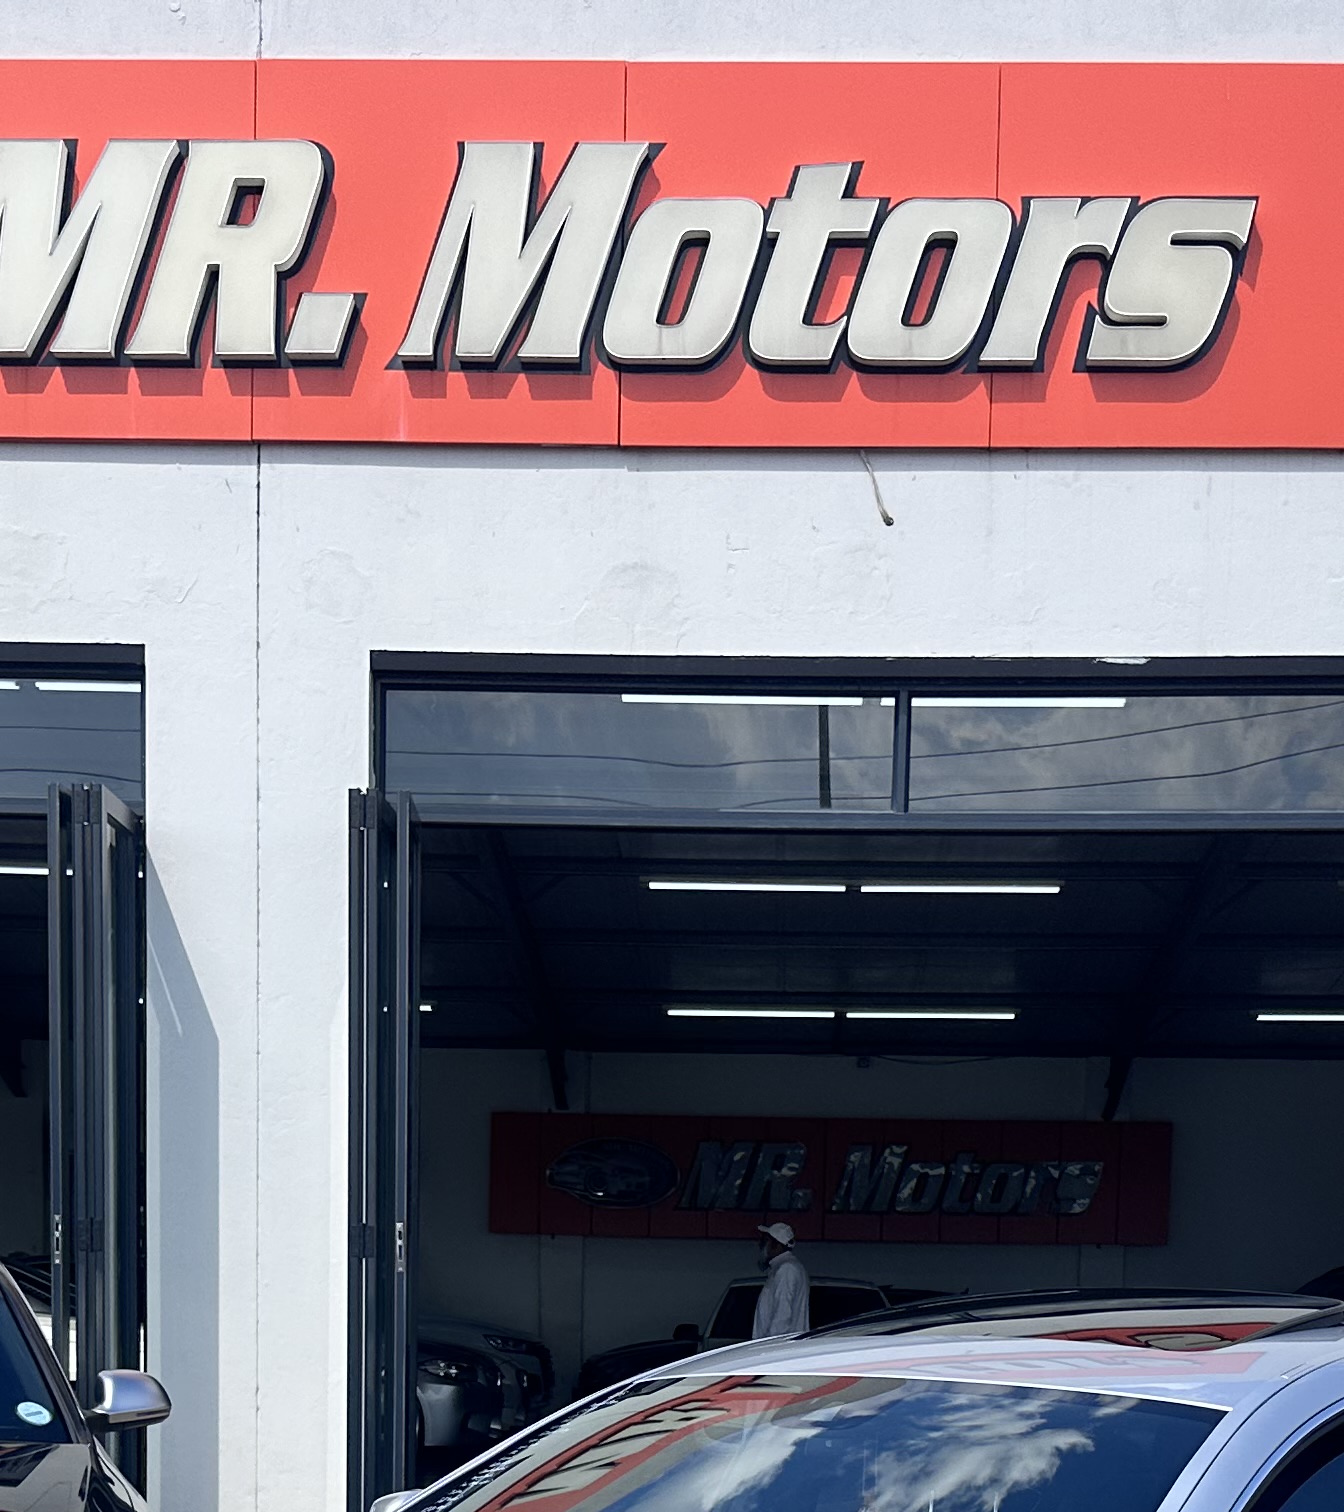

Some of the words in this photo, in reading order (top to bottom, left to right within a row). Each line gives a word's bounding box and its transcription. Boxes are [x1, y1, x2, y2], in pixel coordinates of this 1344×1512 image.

[393, 139, 1259, 368] Motors
[678, 1140, 812, 1212] MR.
[830, 1143, 1105, 1216] Motors
